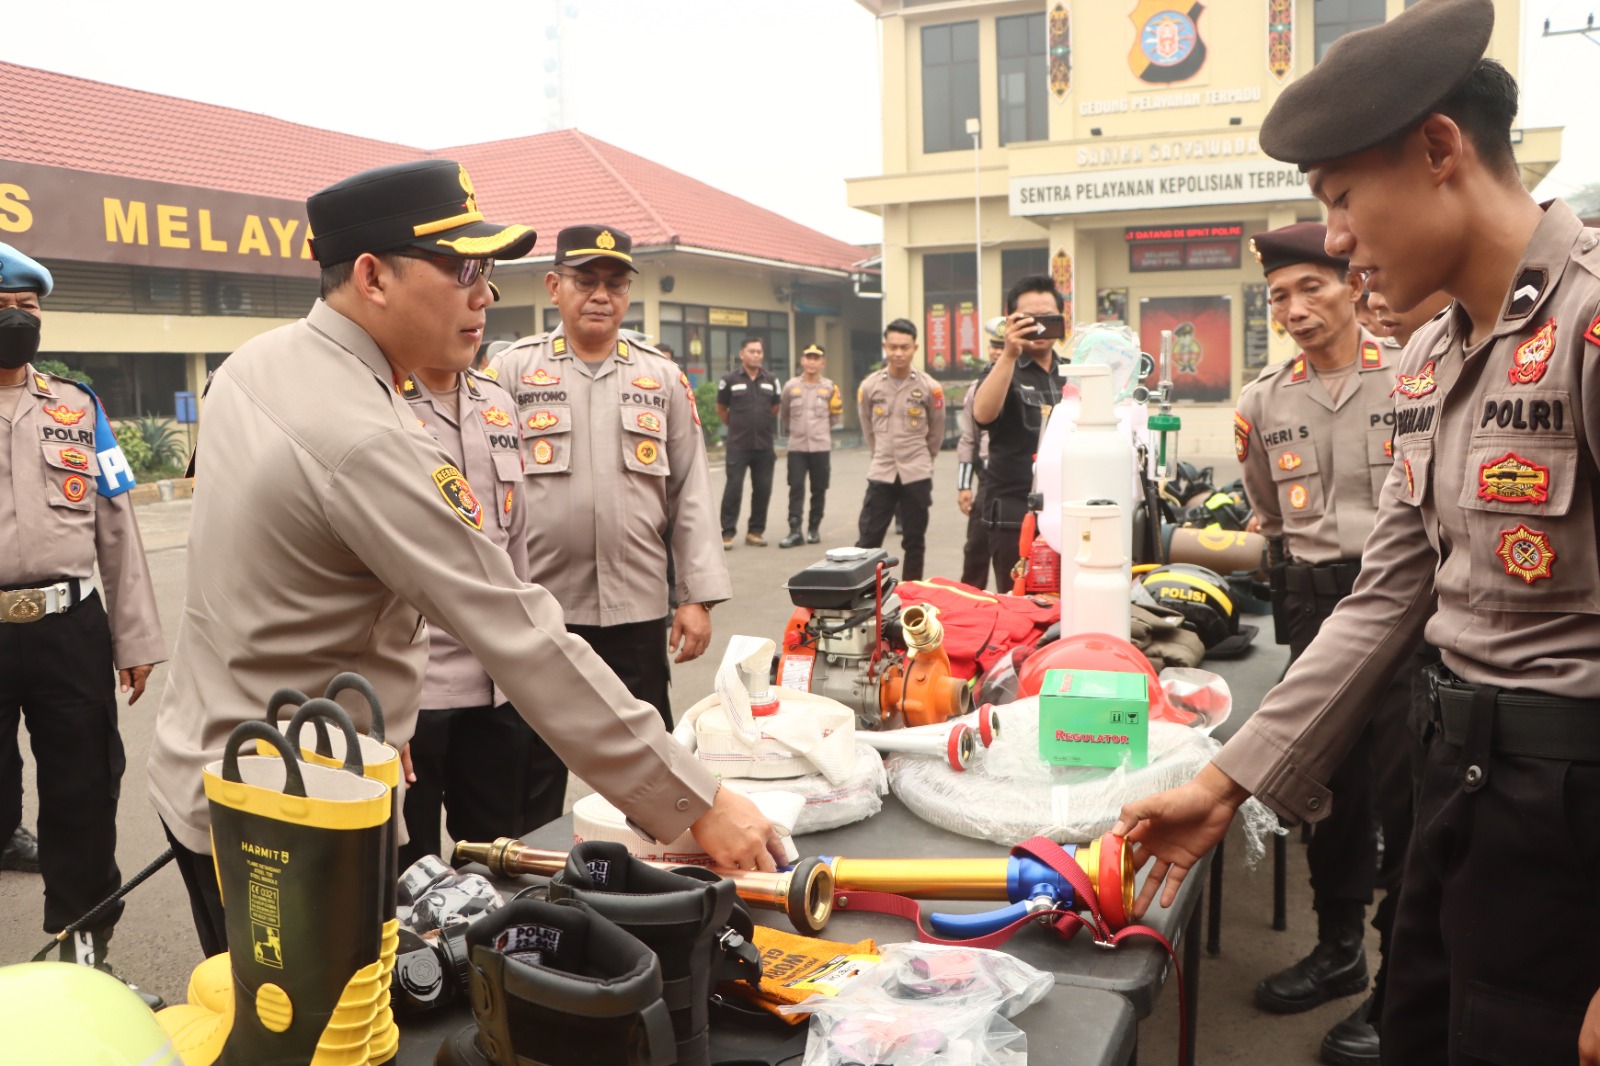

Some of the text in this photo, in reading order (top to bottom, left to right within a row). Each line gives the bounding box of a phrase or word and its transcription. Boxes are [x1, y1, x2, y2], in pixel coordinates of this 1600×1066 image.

[1079, 86, 1262, 116] GEDUNG PELAYANAN TERPADU
[1019, 168, 1306, 204] SENTRA PELAYANAN KEPOLISIAN TERPAD
[1135, 229, 1173, 240] DATANG
[621, 393, 667, 410] POLRI
[1480, 398, 1564, 432] POLRI
[42, 426, 94, 446] POLRI
[1263, 425, 1310, 447] HERI S
[1160, 587, 1207, 604] POLISI
[1054, 729, 1130, 745] REGULATOR
[241, 841, 280, 860] HARMIT
[516, 926, 558, 941] POLRI
